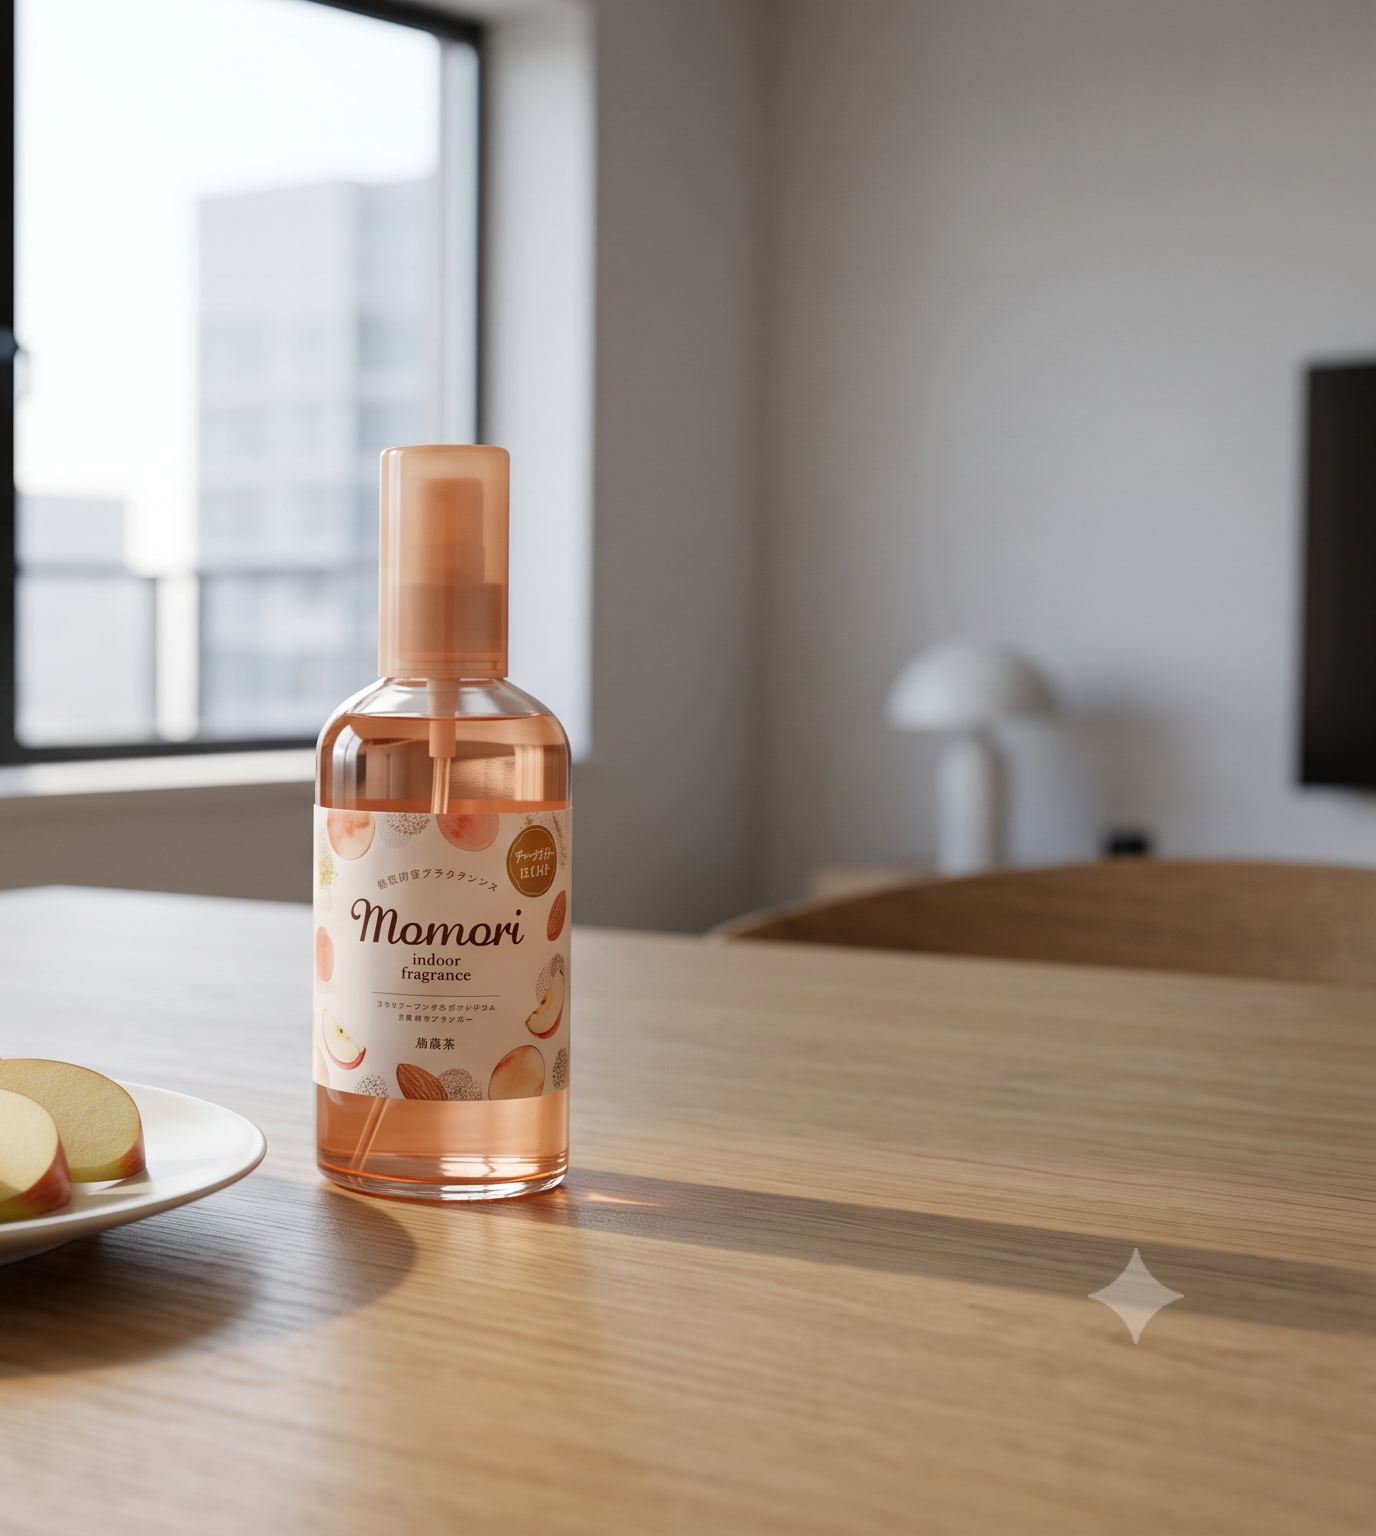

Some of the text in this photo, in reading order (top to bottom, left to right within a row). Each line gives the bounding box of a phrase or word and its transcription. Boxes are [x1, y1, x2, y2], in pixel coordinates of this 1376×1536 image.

[351, 898, 525, 947] Momori
[412, 953, 462, 967] indoor
[401, 966, 472, 984] fragrance
